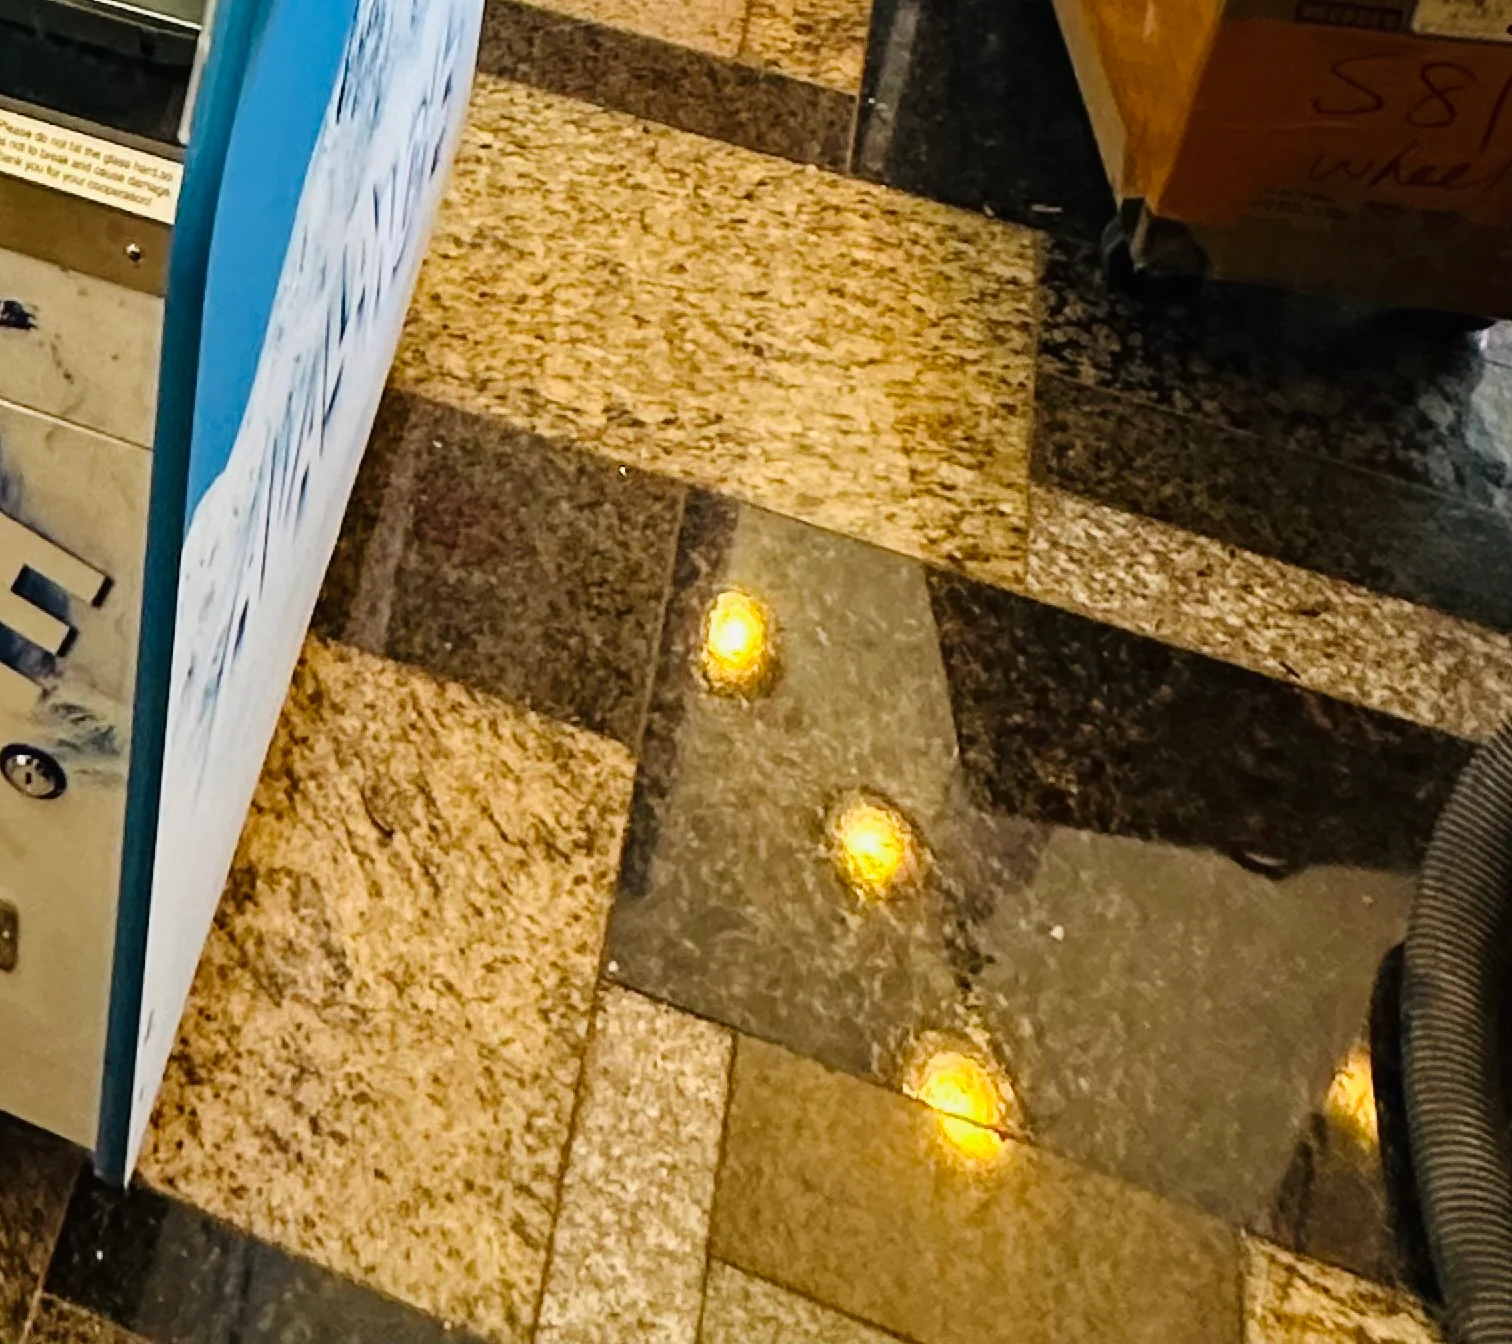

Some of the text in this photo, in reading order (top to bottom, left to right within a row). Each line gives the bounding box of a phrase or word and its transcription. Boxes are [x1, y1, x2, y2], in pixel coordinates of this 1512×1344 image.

[8, 139, 26, 154] not
[27, 143, 38, 157] to
[39, 146, 69, 166] break
[71, 155, 92, 173] and
[93, 164, 125, 182] cause
[34, 129, 48, 144] do
[50, 135, 66, 149] not
[85, 144, 101, 161] the
[102, 152, 130, 171] glass
[24, 159, 44, 174] you
[46, 164, 60, 179] for
[62, 171, 85, 187] your
